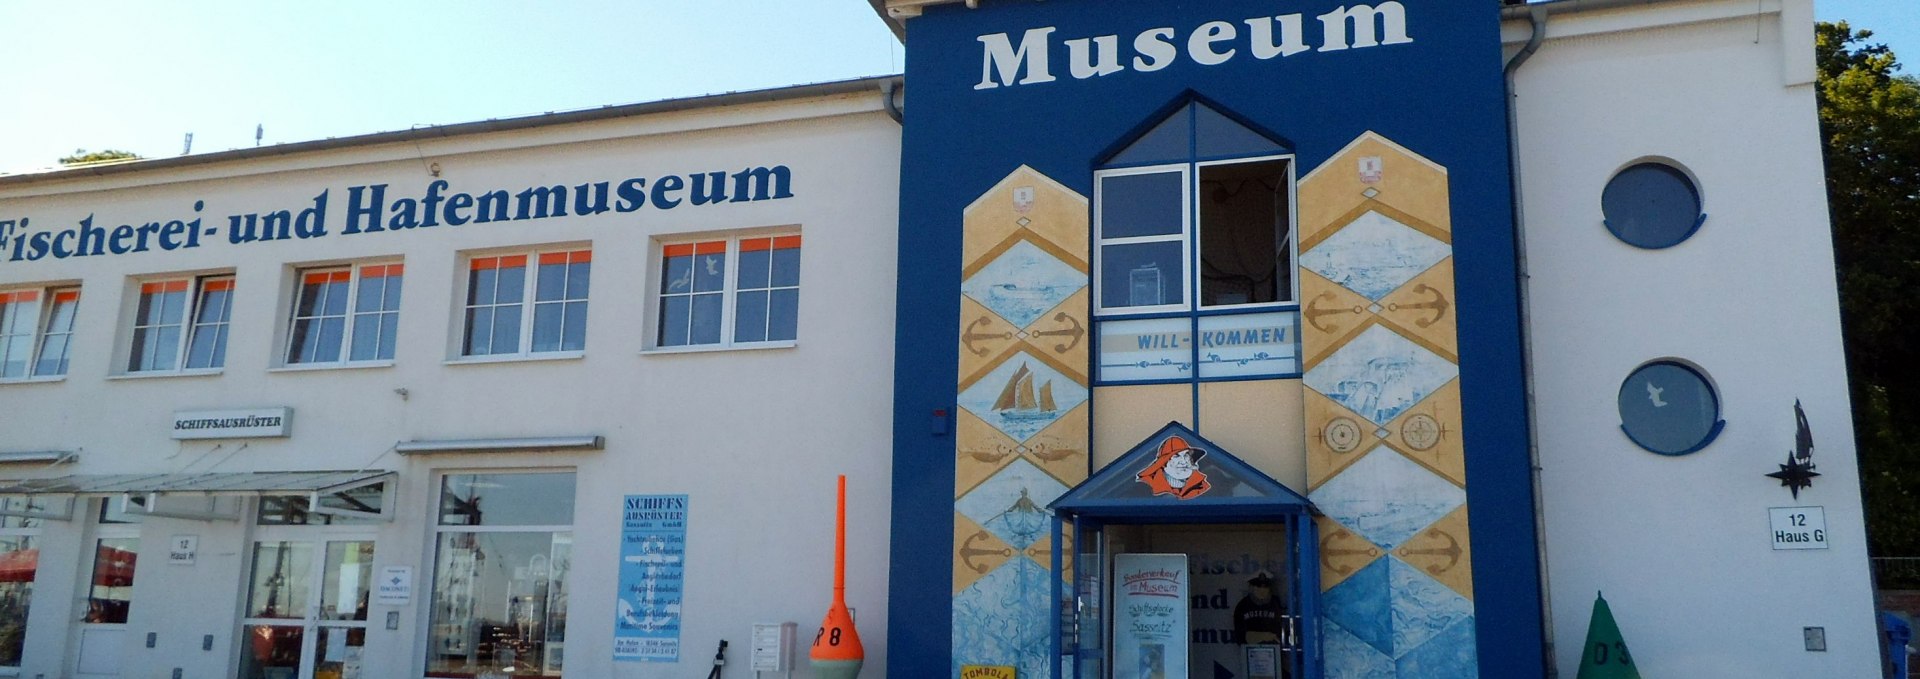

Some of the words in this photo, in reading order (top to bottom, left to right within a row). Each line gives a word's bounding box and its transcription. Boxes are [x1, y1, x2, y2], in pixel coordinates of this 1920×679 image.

[973, 1, 1414, 91] Museum
[228, 187, 330, 244] und
[341, 164, 795, 236] Hafenmuseum
[1137, 333, 1190, 350] WILL-
[1202, 327, 1286, 348] KOMMEN
[174, 415, 281, 430] SCHIFFSAUSRÜSTER
[627, 497, 683, 510] SCHIFFS
[626, 509, 683, 521] AUSRÜSTER
[1788, 513, 1806, 527] 12
[1775, 529, 1810, 543] Haus
[1813, 529, 1825, 543] G
[180, 539, 189, 549] 12
[170, 551, 187, 560] Haus
[188, 551, 194, 560] H
[1138, 581, 1178, 593] Museum
[1243, 611, 1275, 620] MUSEUM
[812, 626, 825, 647] R
[829, 626, 842, 647] 8
[1615, 642, 1630, 665] 3
[962, 668, 1009, 679] TOMBOLA
